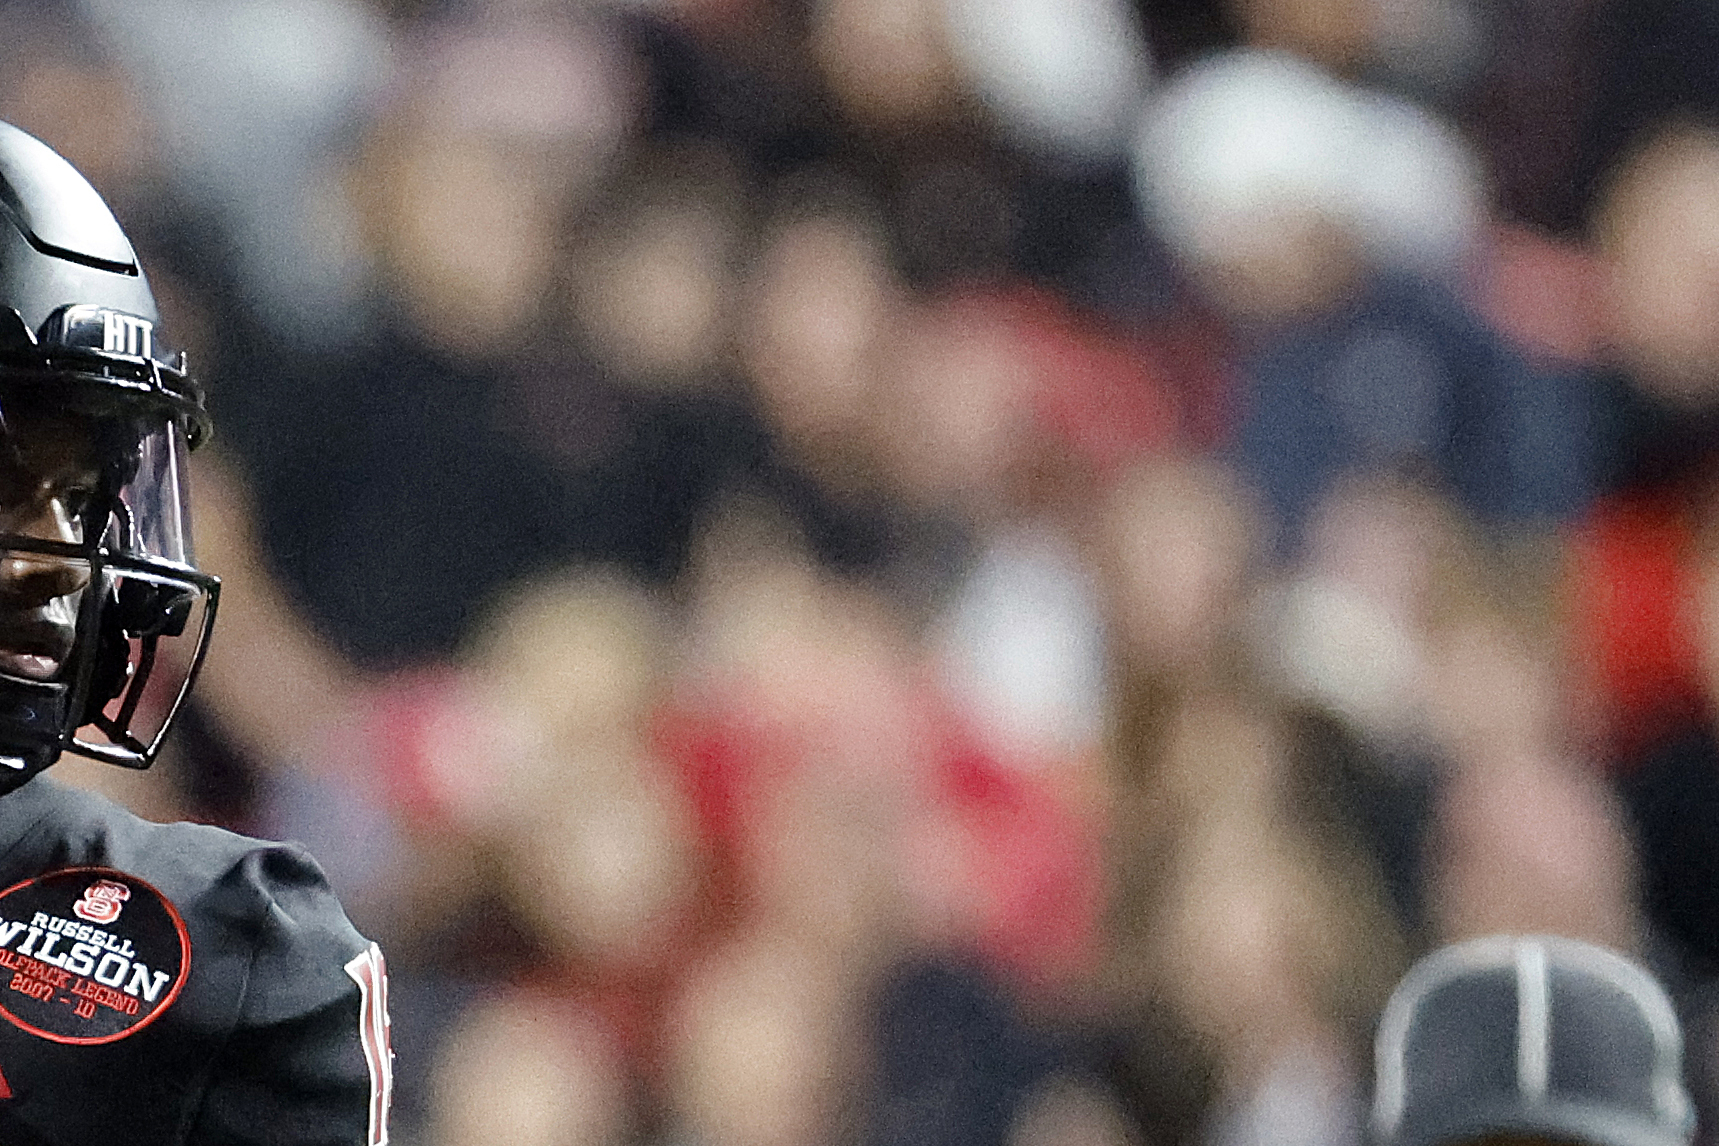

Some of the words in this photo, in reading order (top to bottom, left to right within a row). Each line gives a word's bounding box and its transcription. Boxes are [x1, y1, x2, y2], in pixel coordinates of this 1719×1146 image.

[30, 911, 136, 959] RUSSELL
[9, 972, 55, 1003] 2007
[73, 999, 98, 1020] 10
[70, 978, 141, 1016] LEGEND
